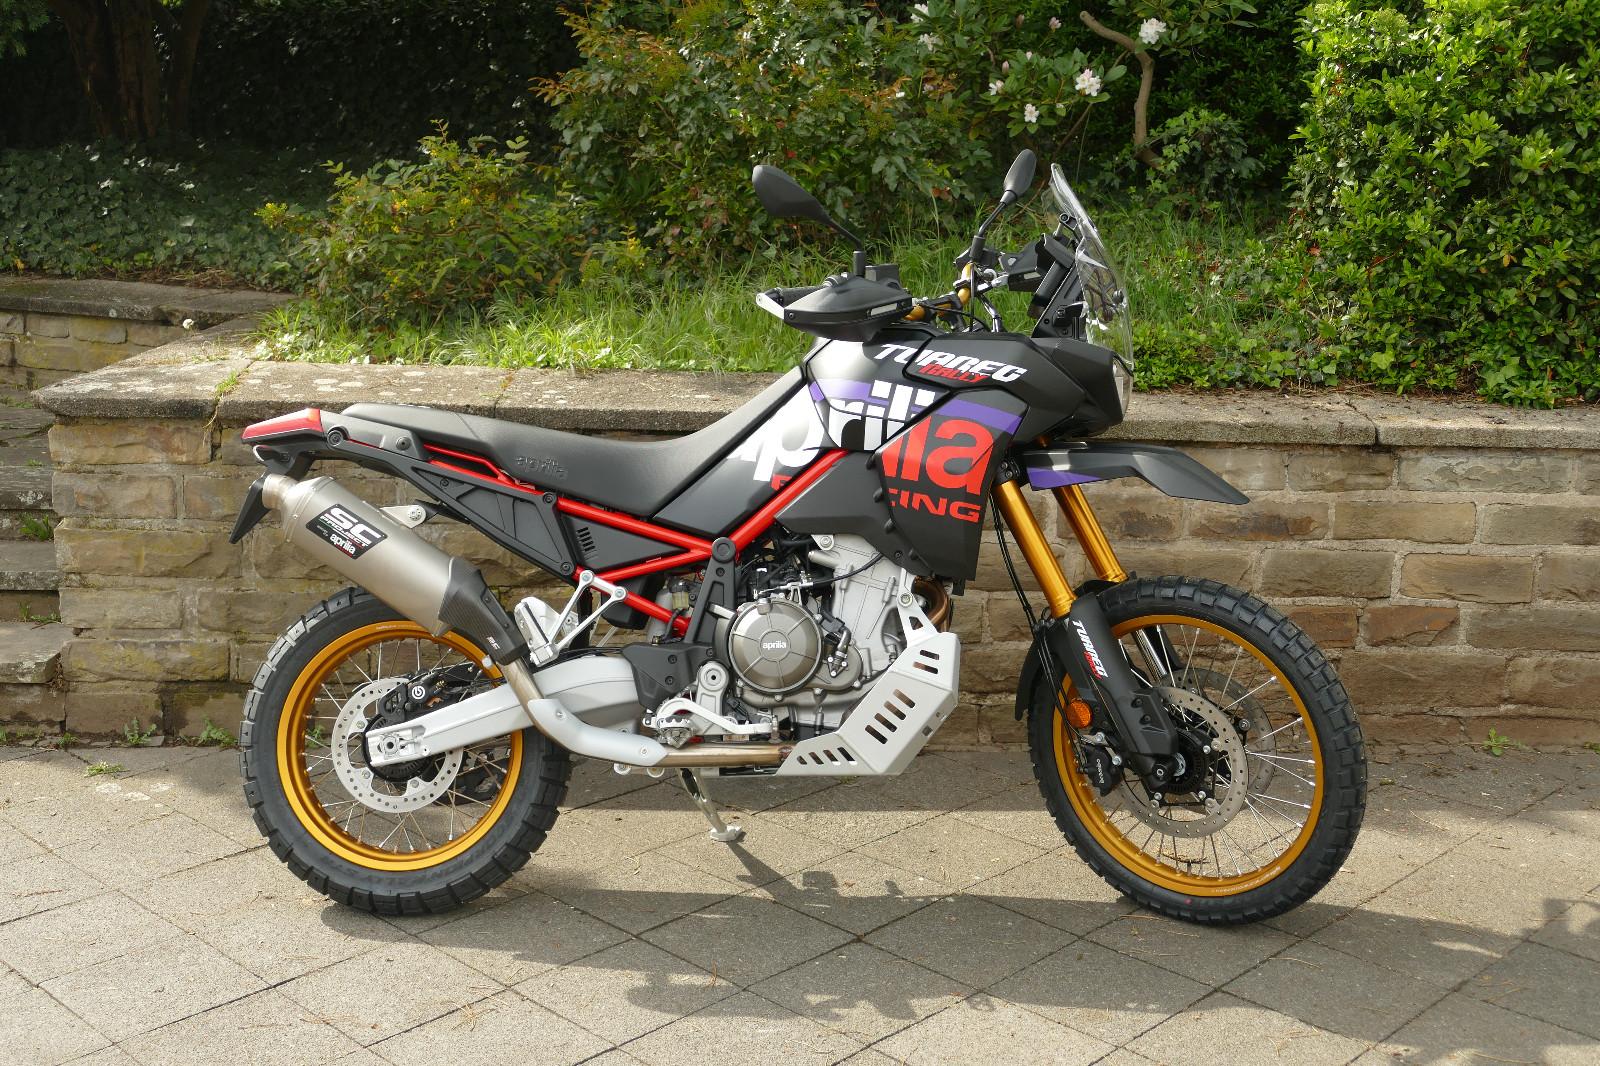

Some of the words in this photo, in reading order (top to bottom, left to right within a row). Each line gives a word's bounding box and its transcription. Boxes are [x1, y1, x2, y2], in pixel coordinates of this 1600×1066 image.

[874, 343, 1027, 383] TUAREG
[917, 363, 990, 383] RALLY
[325, 508, 382, 545] SC
[330, 532, 356, 555] aprilia
[762, 640, 787, 650] aprilia
